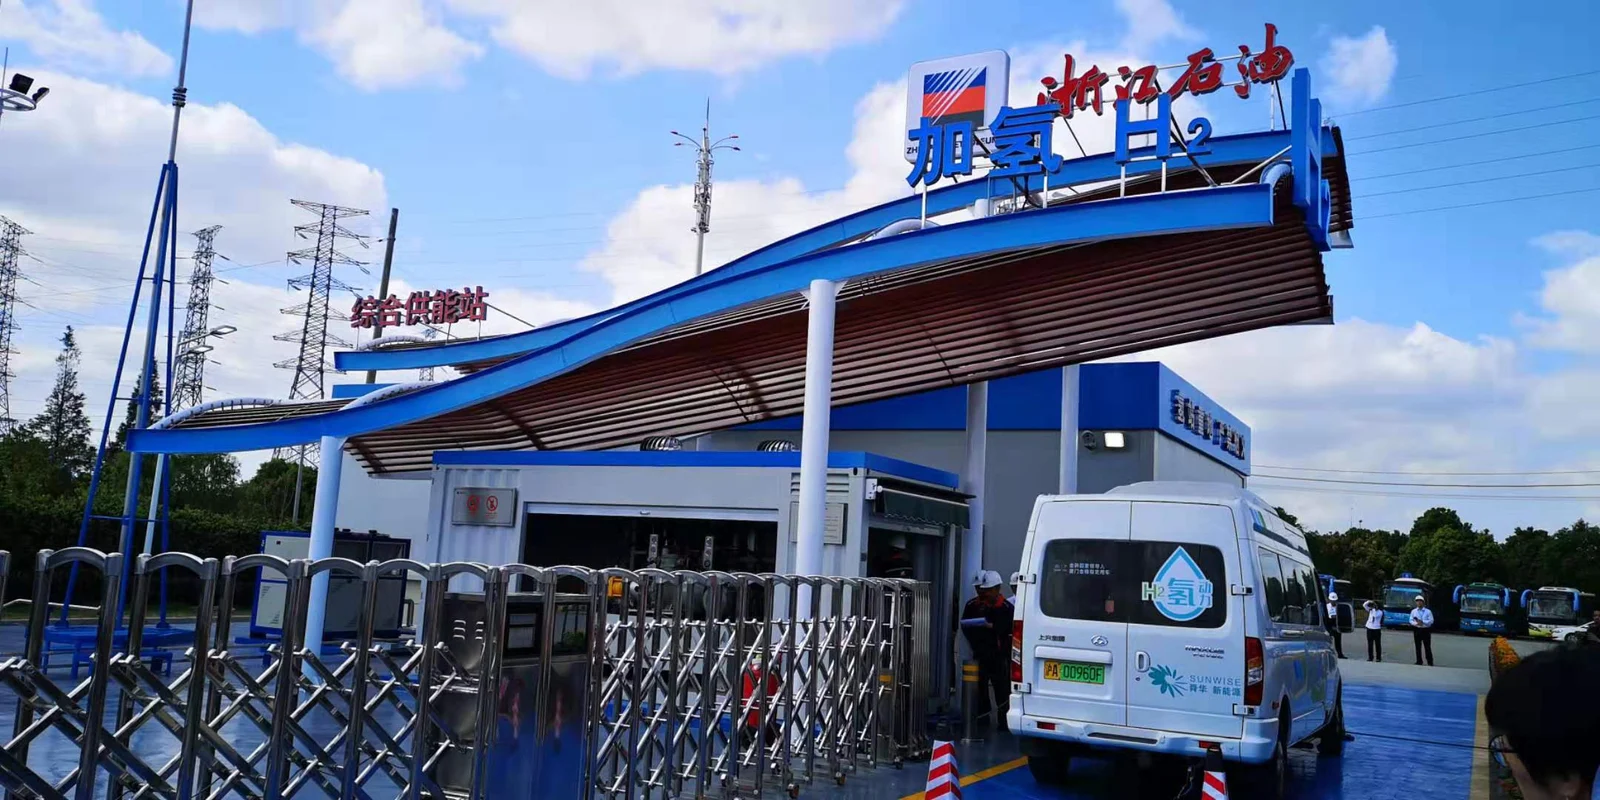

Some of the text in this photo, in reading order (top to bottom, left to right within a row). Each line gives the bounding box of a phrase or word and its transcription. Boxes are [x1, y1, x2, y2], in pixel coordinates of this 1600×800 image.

[1037, 23, 1295, 119] 浙江石油
[906, 104, 1064, 188] 加氢
[350, 285, 489, 329] 综合供能站
[1168, 578, 1196, 606] 氢
[1199, 580, 1213, 607] 动力
[1189, 675, 1241, 687] SUNWISE
[1212, 685, 1241, 697] 新能源
